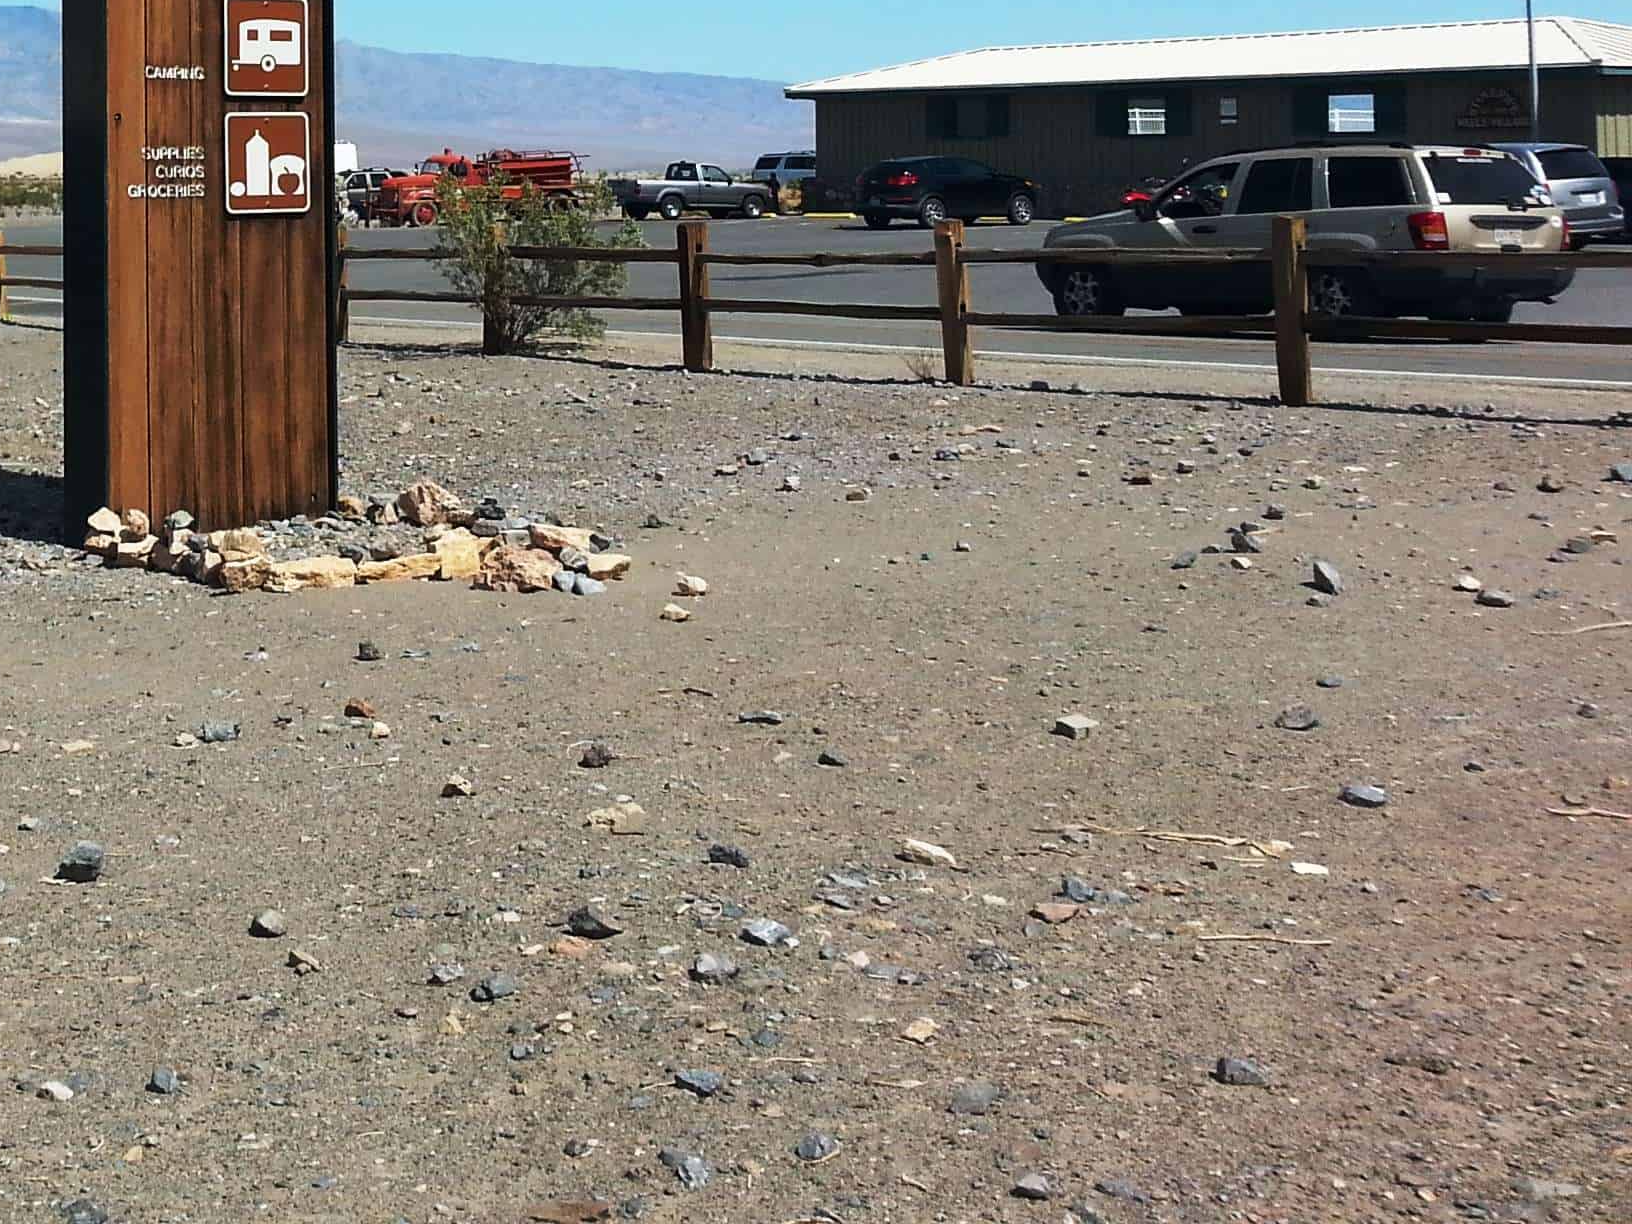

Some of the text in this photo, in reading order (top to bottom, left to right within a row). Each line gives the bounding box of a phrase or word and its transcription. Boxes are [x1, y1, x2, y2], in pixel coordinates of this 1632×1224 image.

[145, 65, 205, 80] CAMPING
[142, 147, 205, 160] SUPPLIES
[156, 165, 205, 179] CURIOS
[128, 184, 205, 198] GROCERIES
